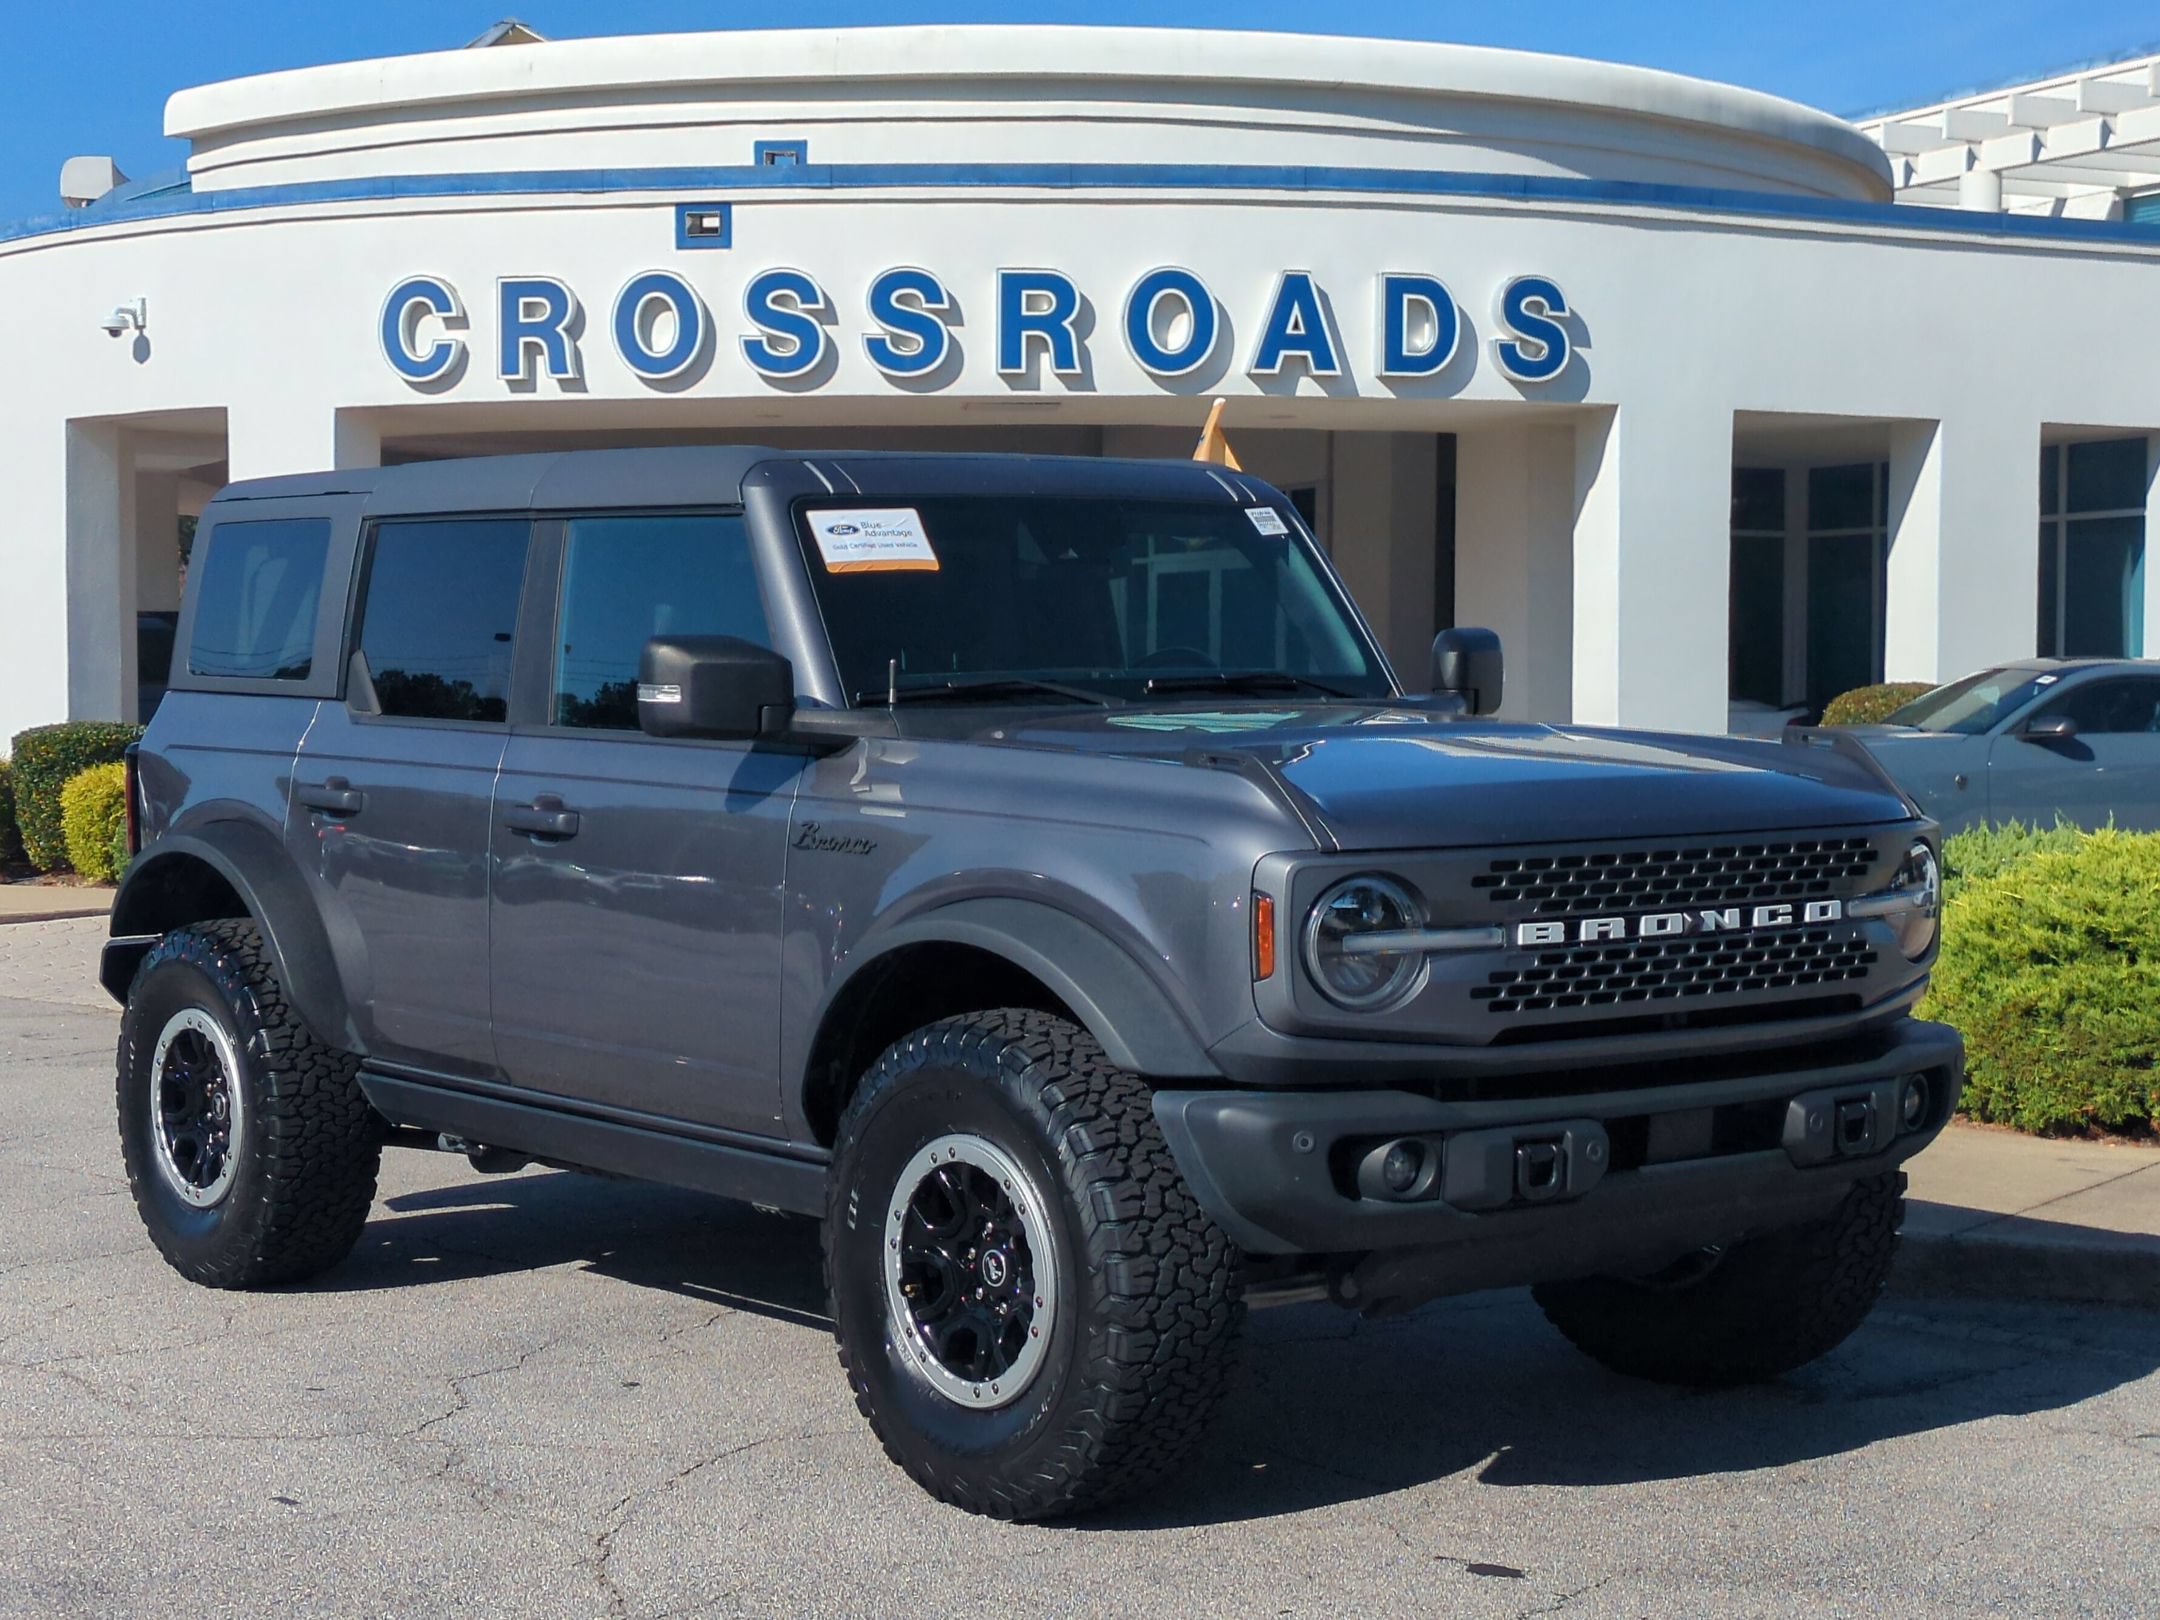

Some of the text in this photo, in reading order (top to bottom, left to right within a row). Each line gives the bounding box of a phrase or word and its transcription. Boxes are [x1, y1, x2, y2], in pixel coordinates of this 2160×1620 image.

[378, 265, 1571, 383] CROSSROADS
[860, 521, 882, 529] Blue
[864, 529, 912, 537] Advantage
[792, 822, 877, 855] Bronco
[1517, 900, 1842, 946] BRONCO
